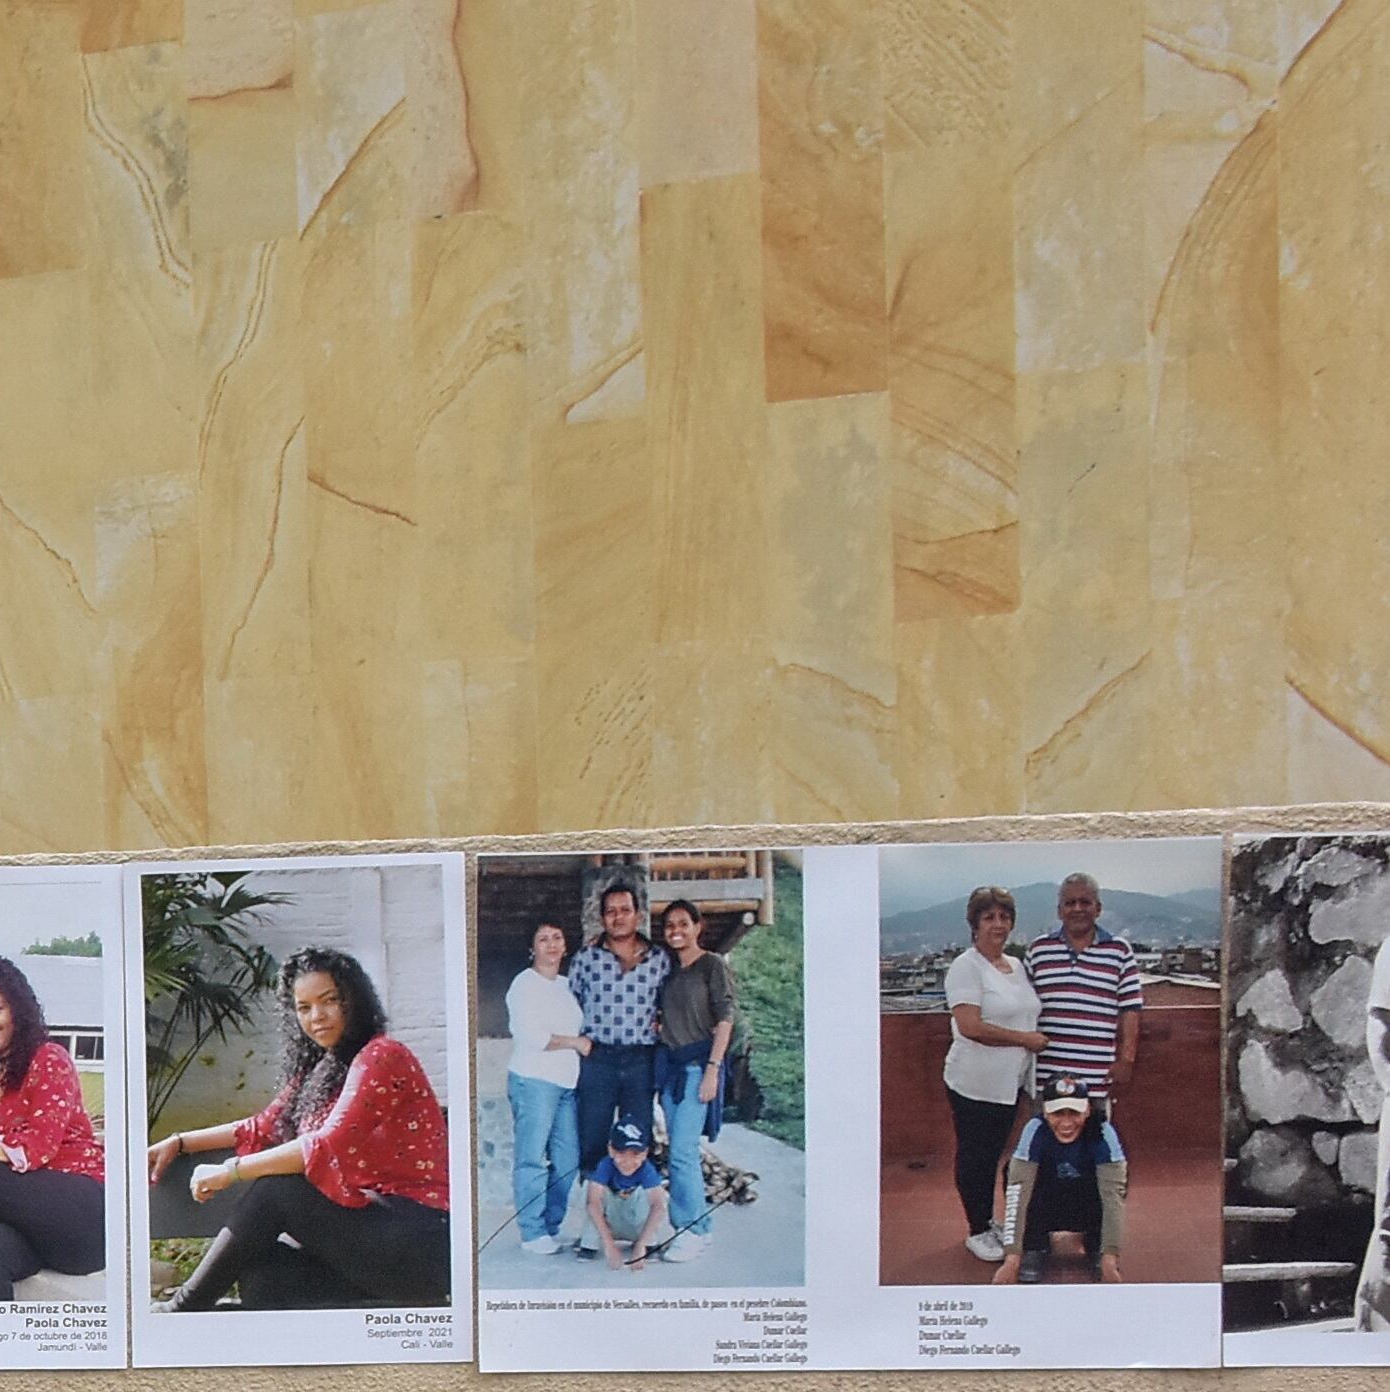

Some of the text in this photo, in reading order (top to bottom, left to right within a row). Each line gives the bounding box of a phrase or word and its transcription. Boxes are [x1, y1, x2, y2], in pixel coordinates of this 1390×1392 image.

[62, 1304, 107, 1313] Chavez
[25, 1318, 107, 1328] Paola Chavez
[365, 1313, 452, 1324] Paola Chavez
[11, 1332, 17, 1340] 7
[19, 1332, 31, 1340] de
[70, 1331, 82, 1340] de
[367, 1328, 452, 1339] Septiembre 2021
[84, 1343, 107, 1351] Valle
[429, 1340, 453, 1348] Valle
